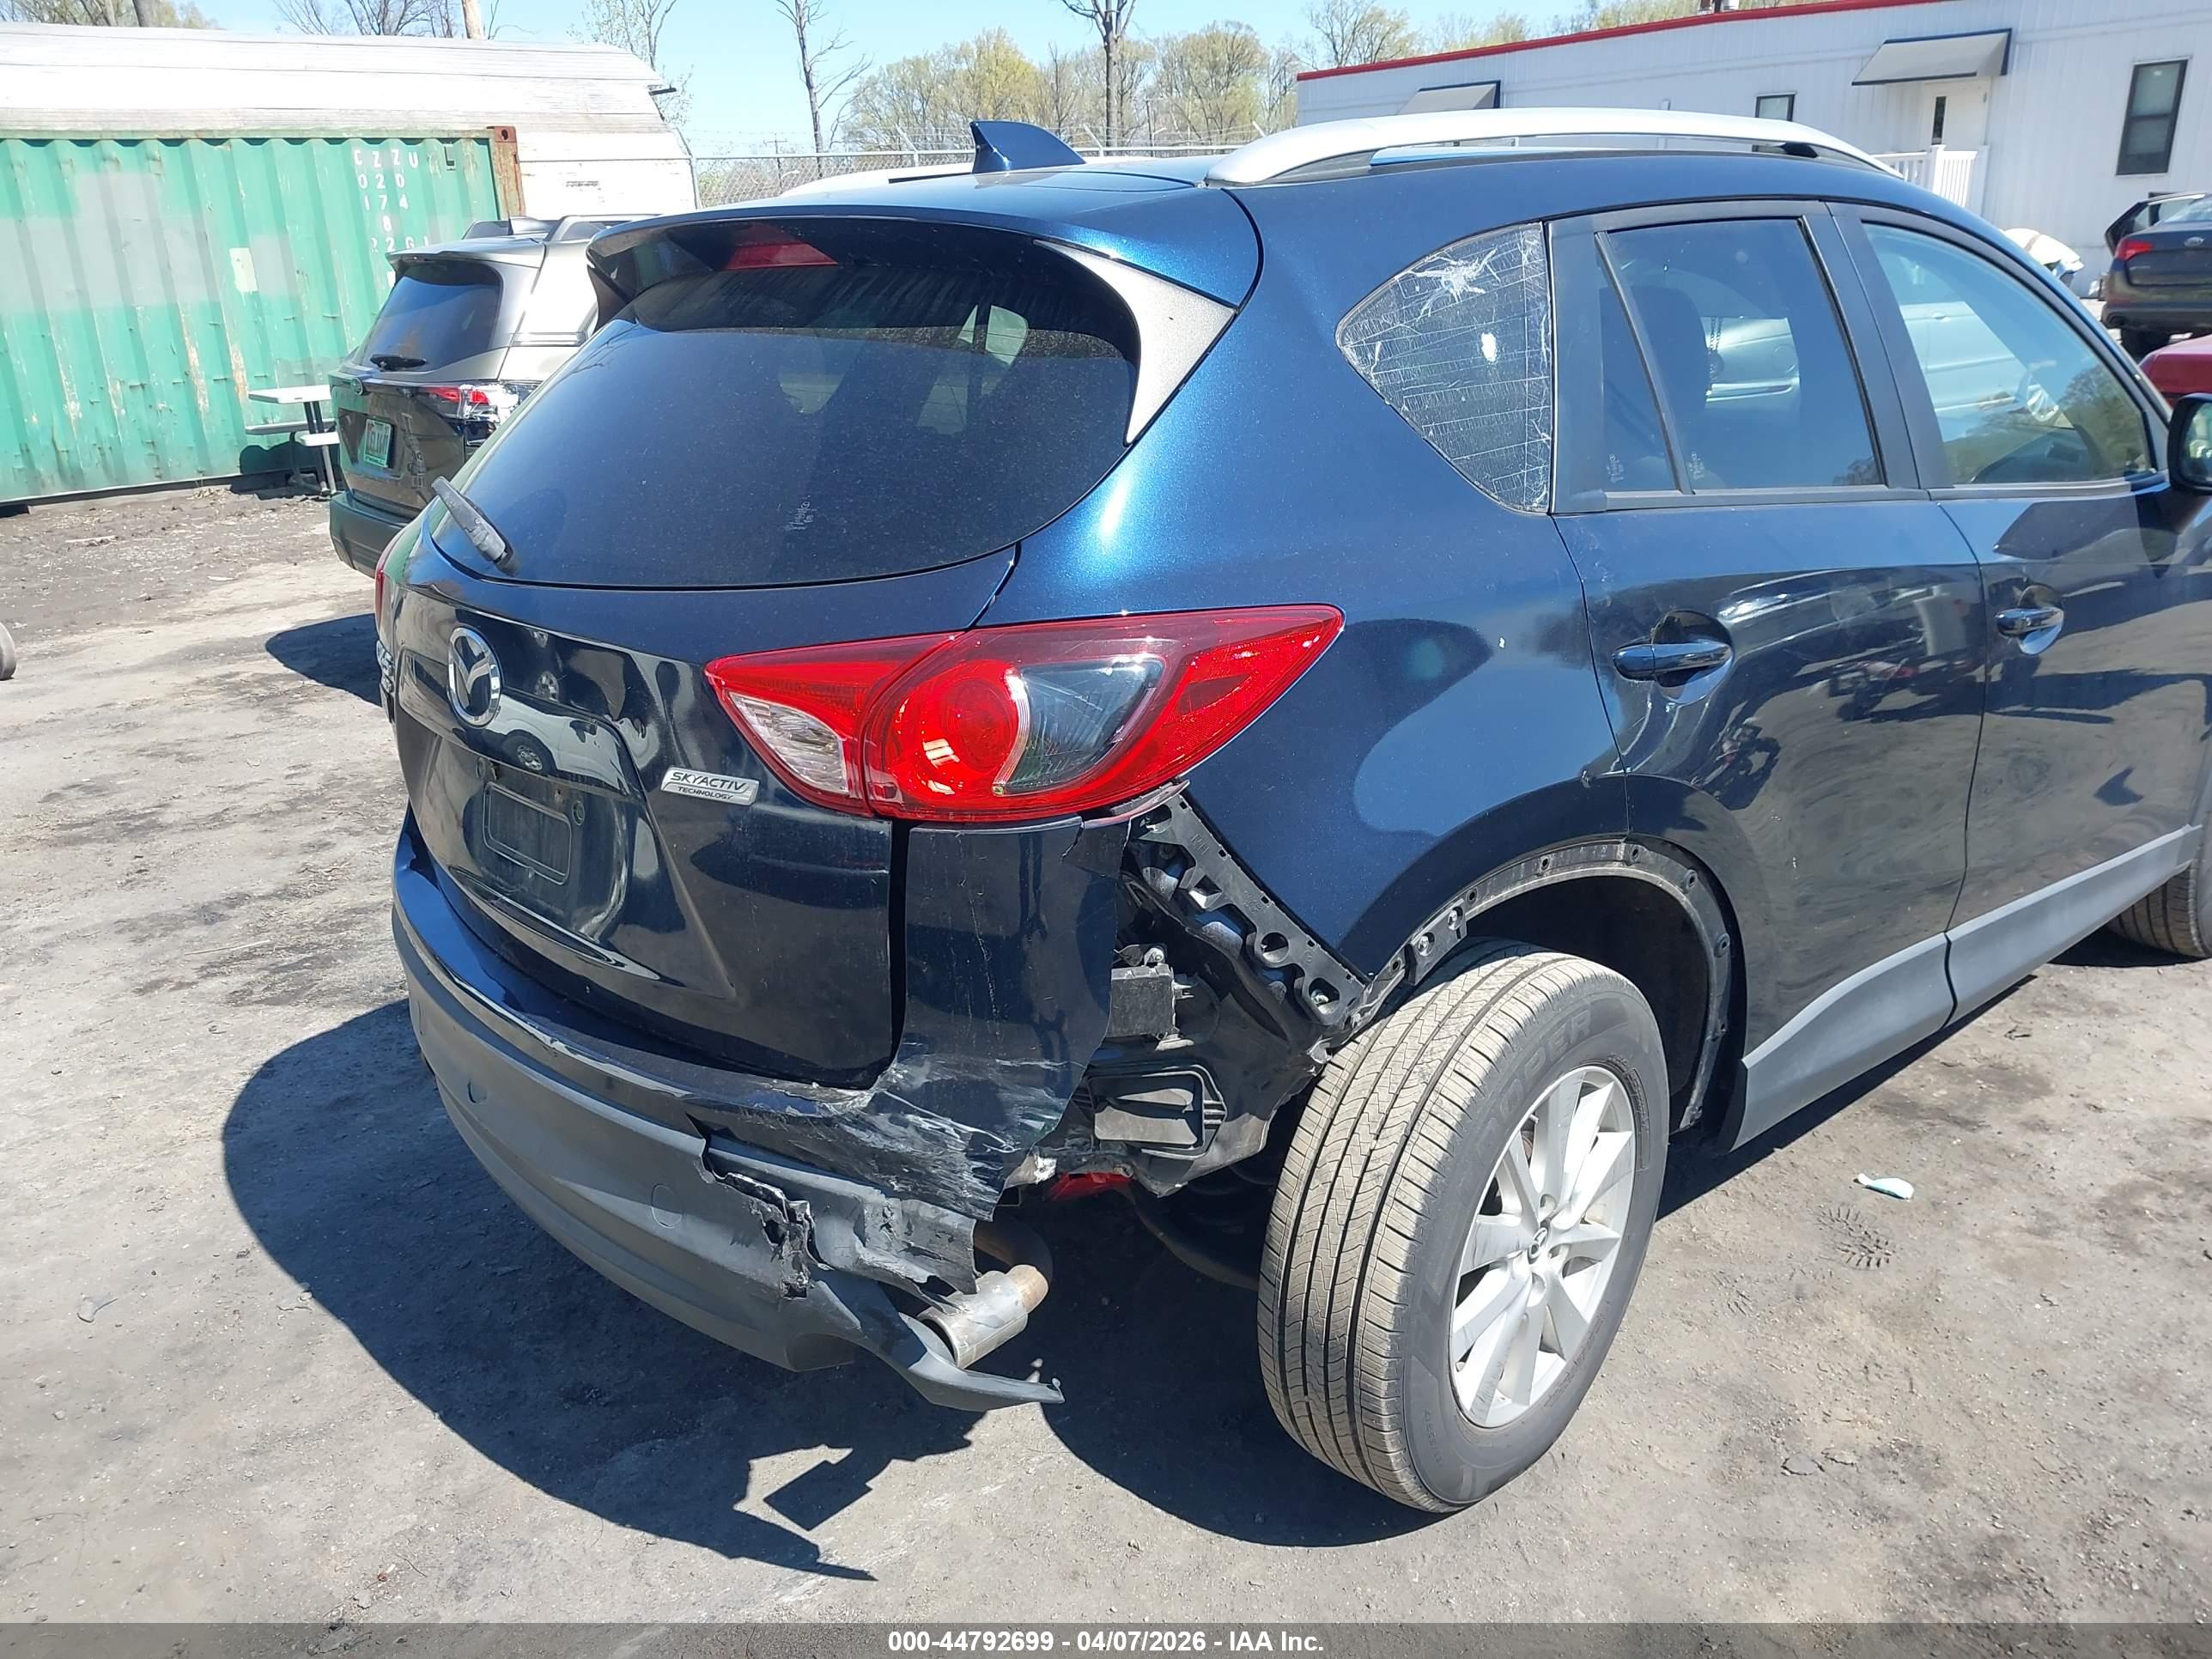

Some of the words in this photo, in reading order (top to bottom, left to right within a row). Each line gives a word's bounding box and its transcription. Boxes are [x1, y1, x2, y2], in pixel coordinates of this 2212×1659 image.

[353, 149, 419, 168] CZZU
[357, 173, 405, 189] 020
[364, 193, 409, 210] 174
[382, 215, 392, 232] 8
[671, 771, 747, 791] SKYACTIV
[678, 786, 734, 800] TECHNOLOGY
